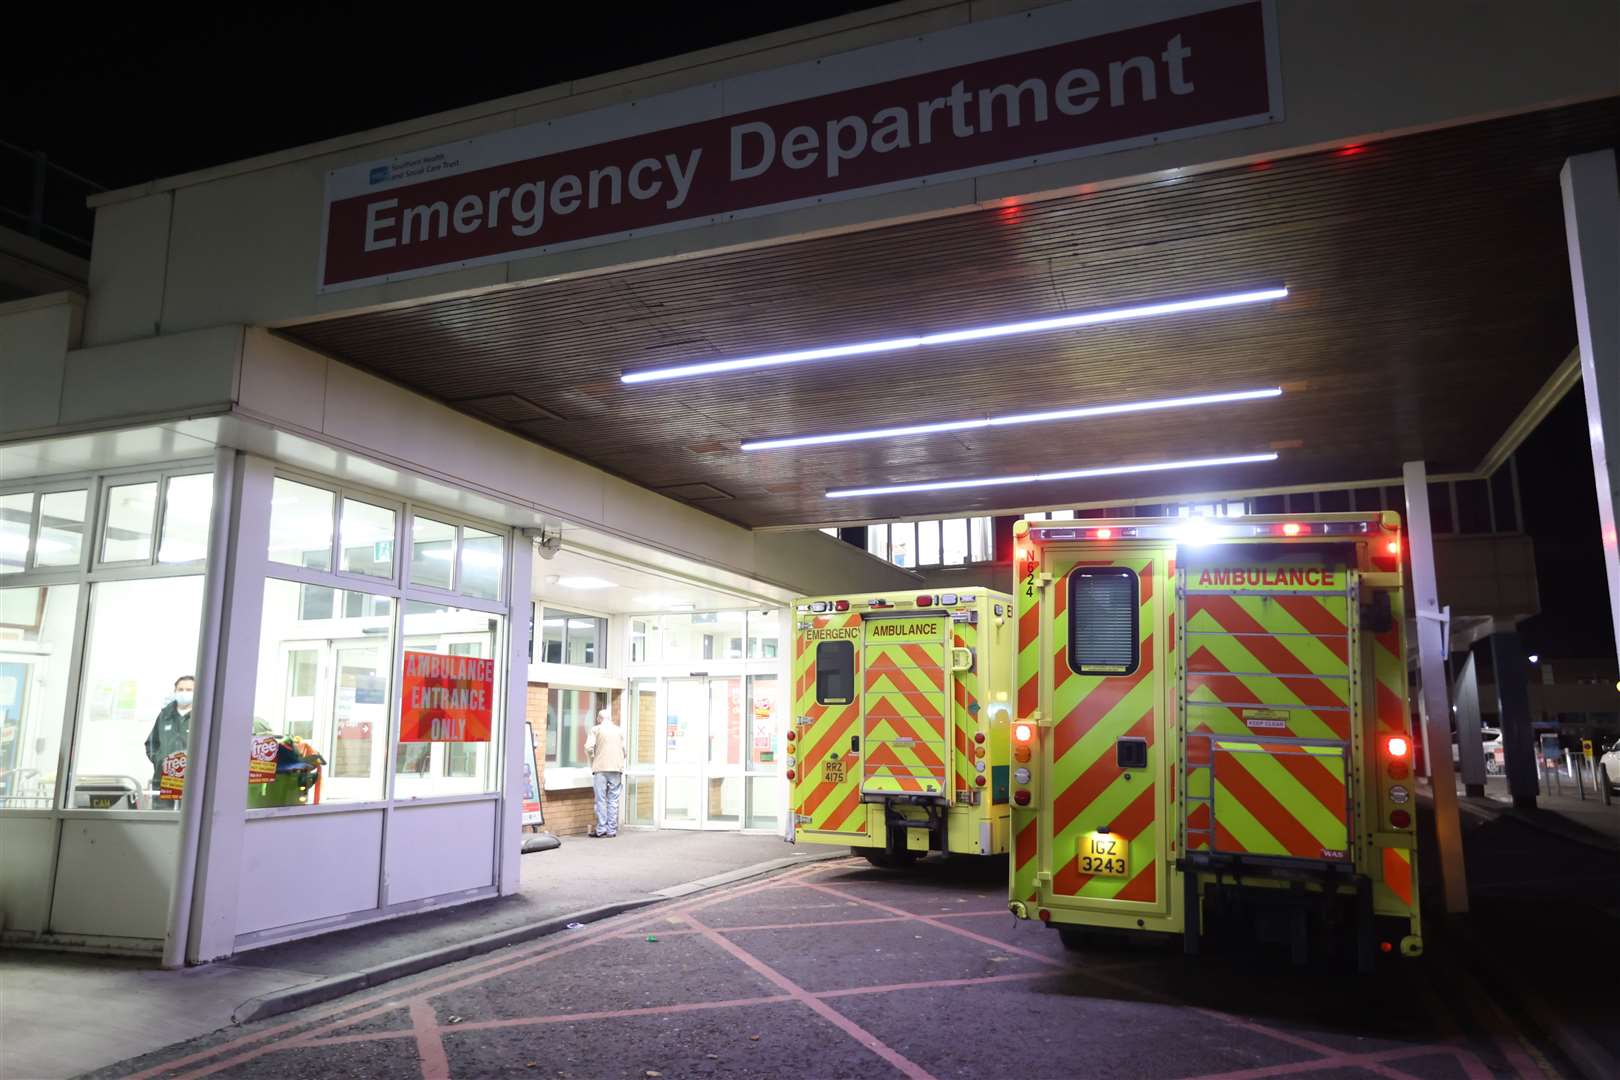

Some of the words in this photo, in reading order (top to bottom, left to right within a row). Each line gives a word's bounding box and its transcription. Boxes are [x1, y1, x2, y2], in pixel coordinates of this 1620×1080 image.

[364, 148, 703, 252] Emergency
[730, 33, 1195, 182] Department
[1199, 568, 1335, 586] AMBULANCE
[873, 624, 937, 637] AMBULANCE
[406, 655, 493, 682] AMBULANCE
[411, 686, 486, 711] ENTRANCE
[431, 718, 466, 741] ONLY
[825, 772, 844, 782] 4175
[1091, 839, 1117, 856] IGZ
[1082, 856, 1126, 874] 3243
